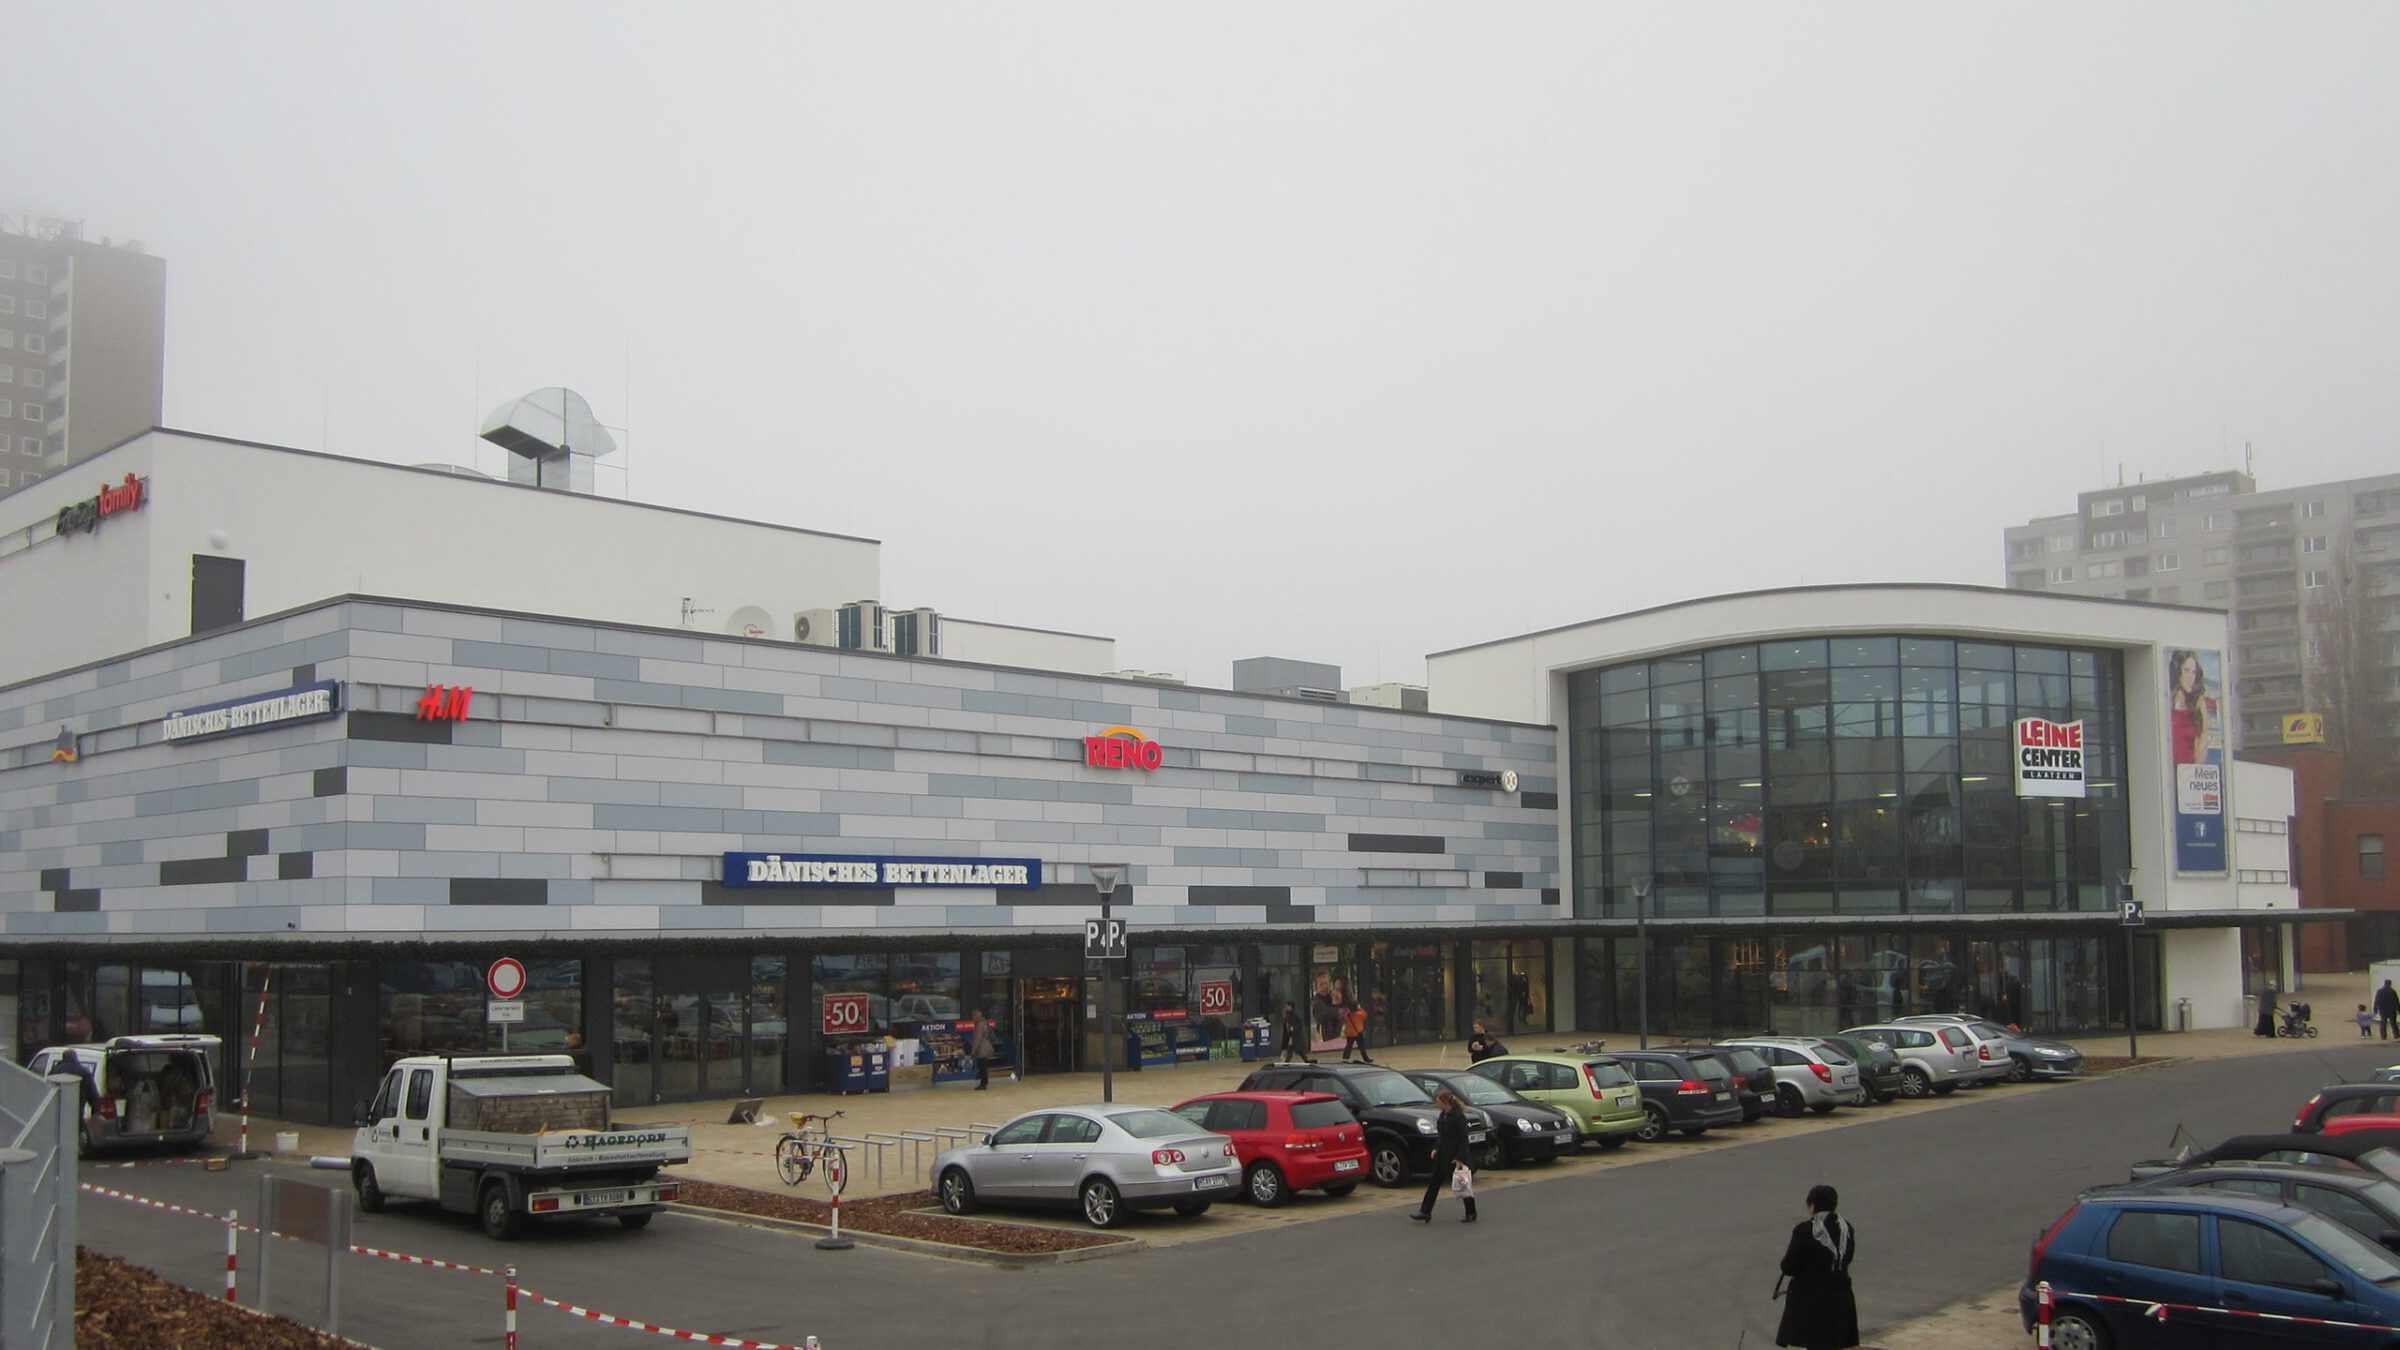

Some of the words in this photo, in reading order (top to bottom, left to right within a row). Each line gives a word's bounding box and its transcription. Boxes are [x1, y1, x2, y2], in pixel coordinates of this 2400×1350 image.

[163, 709, 229, 741] DÄNISCHES
[230, 689, 331, 729] BETTENLAGER
[2020, 720, 2082, 749] LEINE
[1085, 736, 1163, 771] RENO
[2021, 747, 2082, 769] CENTER
[2030, 771, 2075, 779] LAATZEN
[2194, 767, 2219, 780] Mein
[2189, 780, 2219, 792] neues
[748, 855, 878, 883] DÄNISCHES
[882, 862, 1029, 885] BETTENLAGER
[920, 1023, 946, 1031] AKTION
[583, 1132, 666, 1150] HAGEDORN
